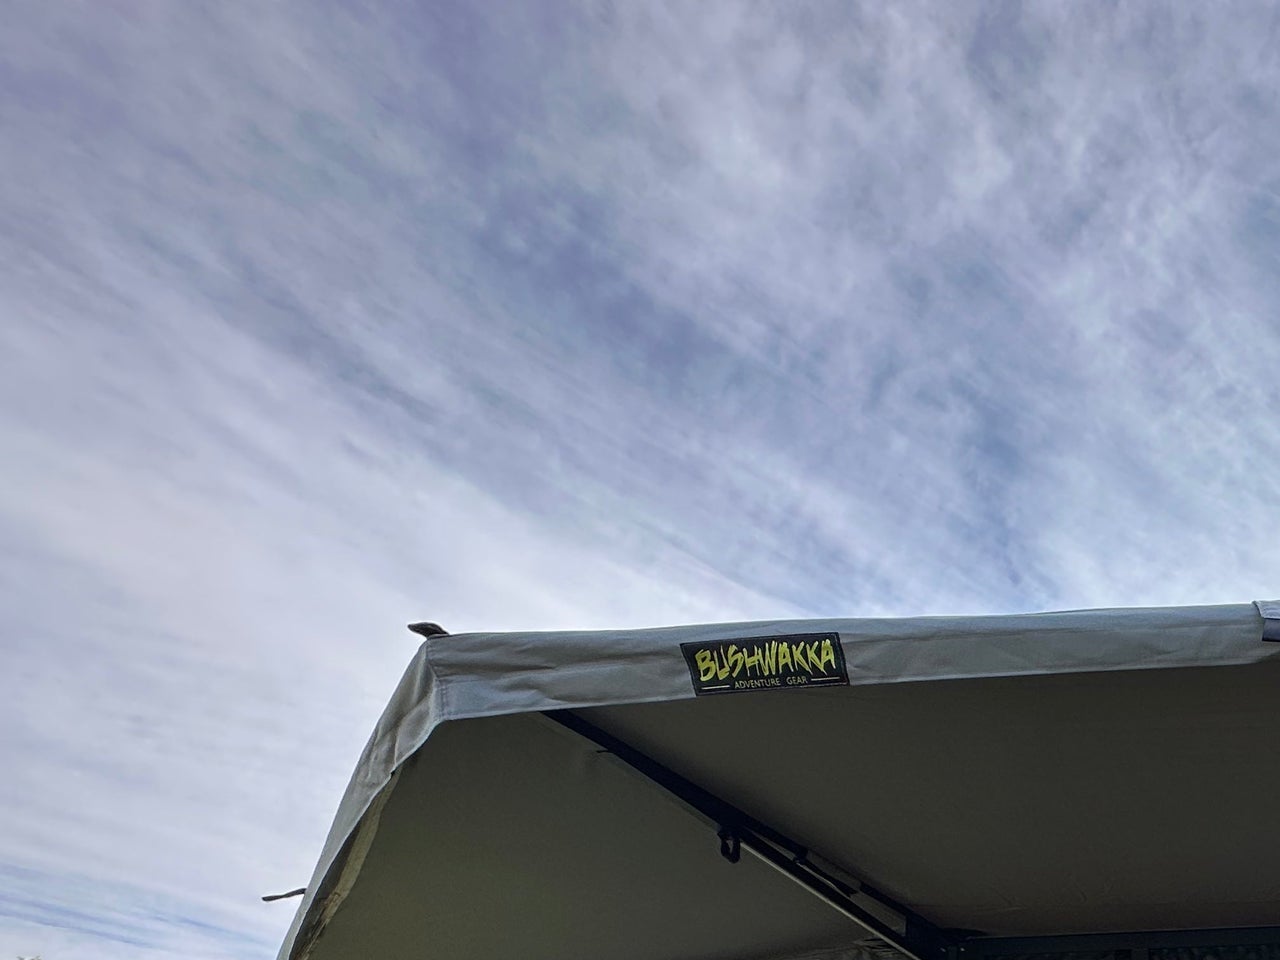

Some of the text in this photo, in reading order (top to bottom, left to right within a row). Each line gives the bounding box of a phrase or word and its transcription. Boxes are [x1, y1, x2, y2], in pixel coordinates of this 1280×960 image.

[695, 639, 836, 682] BUSHWAKKA
[734, 676, 808, 689] ADVENTURE GEAR
